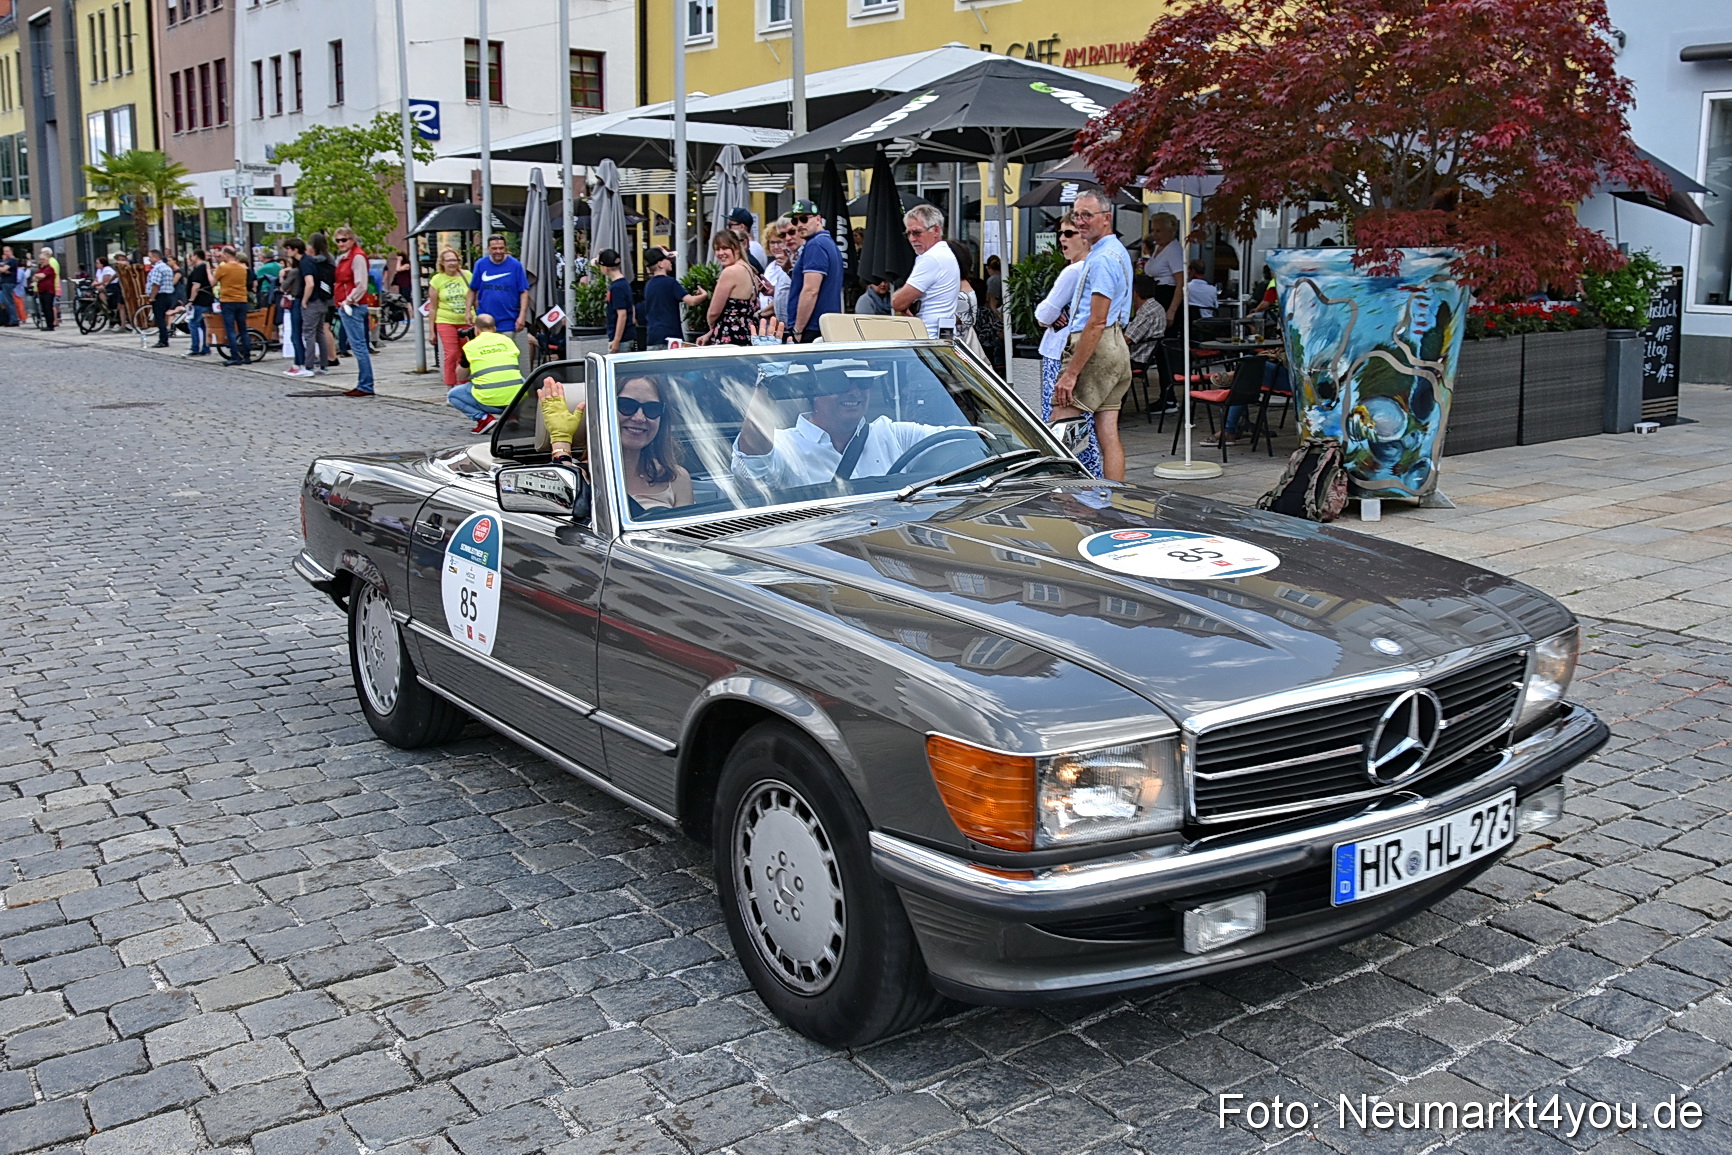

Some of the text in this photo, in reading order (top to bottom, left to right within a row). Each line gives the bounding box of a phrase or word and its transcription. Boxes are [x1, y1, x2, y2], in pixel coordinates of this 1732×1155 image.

[1062, 47, 1087, 68] AM
[840, 94, 940, 143] now
[1167, 547, 1223, 562] 85
[460, 586, 478, 622] 85
[1359, 839, 1402, 892] HR
[1425, 822, 1463, 871] HL
[1469, 799, 1513, 854] 273
